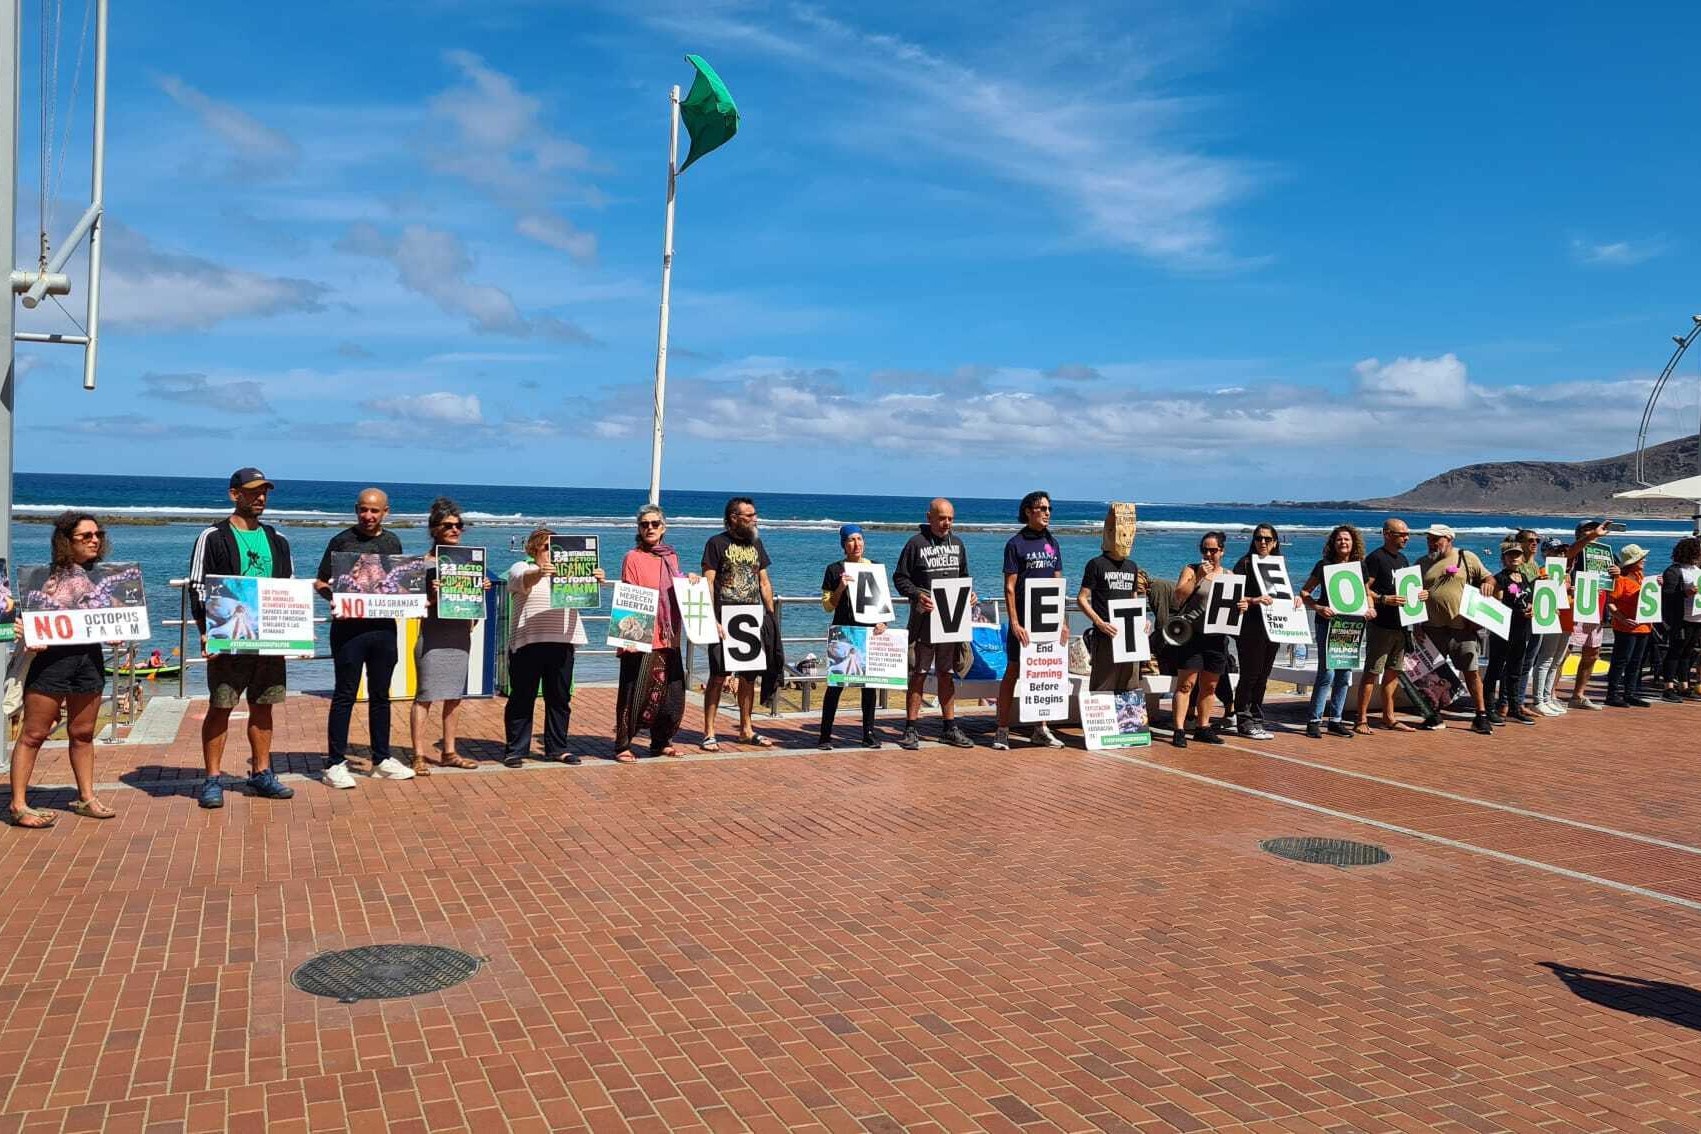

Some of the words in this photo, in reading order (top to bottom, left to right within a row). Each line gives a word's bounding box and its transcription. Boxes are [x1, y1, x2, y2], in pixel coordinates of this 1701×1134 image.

[554, 562, 597, 576] AGAINST
[473, 576, 483, 588] LA
[553, 576, 597, 584] OCTOPUS
[1257, 563, 1292, 599] E
[553, 583, 597, 593] FARM
[855, 571, 891, 614] A
[1328, 570, 1365, 613] O
[441, 594, 483, 602] PULPOS
[620, 592, 653, 604] MERECEN
[1399, 574, 1425, 617] C
[1576, 578, 1597, 616] U
[1639, 582, 1659, 617] S
[341, 598, 364, 618] NO
[369, 599, 373, 607] A
[375, 599, 386, 607] LAS
[388, 599, 419, 607] GRANJAS
[616, 599, 654, 612] LIBERTAD
[1031, 587, 1059, 632] E
[1207, 581, 1243, 626] H
[1533, 586, 1557, 627] O
[369, 609, 376, 617] DE
[379, 609, 404, 617] PULPOS
[682, 589, 711, 636] #
[932, 587, 971, 634] V
[84, 612, 139, 625] OCTOPUS
[1266, 614, 1288, 622] Save
[34, 615, 74, 640] NO
[86, 625, 140, 638] FARM
[1113, 607, 1142, 652] T
[1267, 621, 1284, 629] The
[1333, 621, 1364, 629] ACTO
[727, 613, 761, 662] S
[1036, 643, 1053, 653] End
[1026, 657, 1062, 667] Octopus
[1026, 669, 1062, 679] Farming
[1029, 682, 1059, 692] Before
[1025, 695, 1032, 704] It
[1033, 694, 1063, 705] Begins
